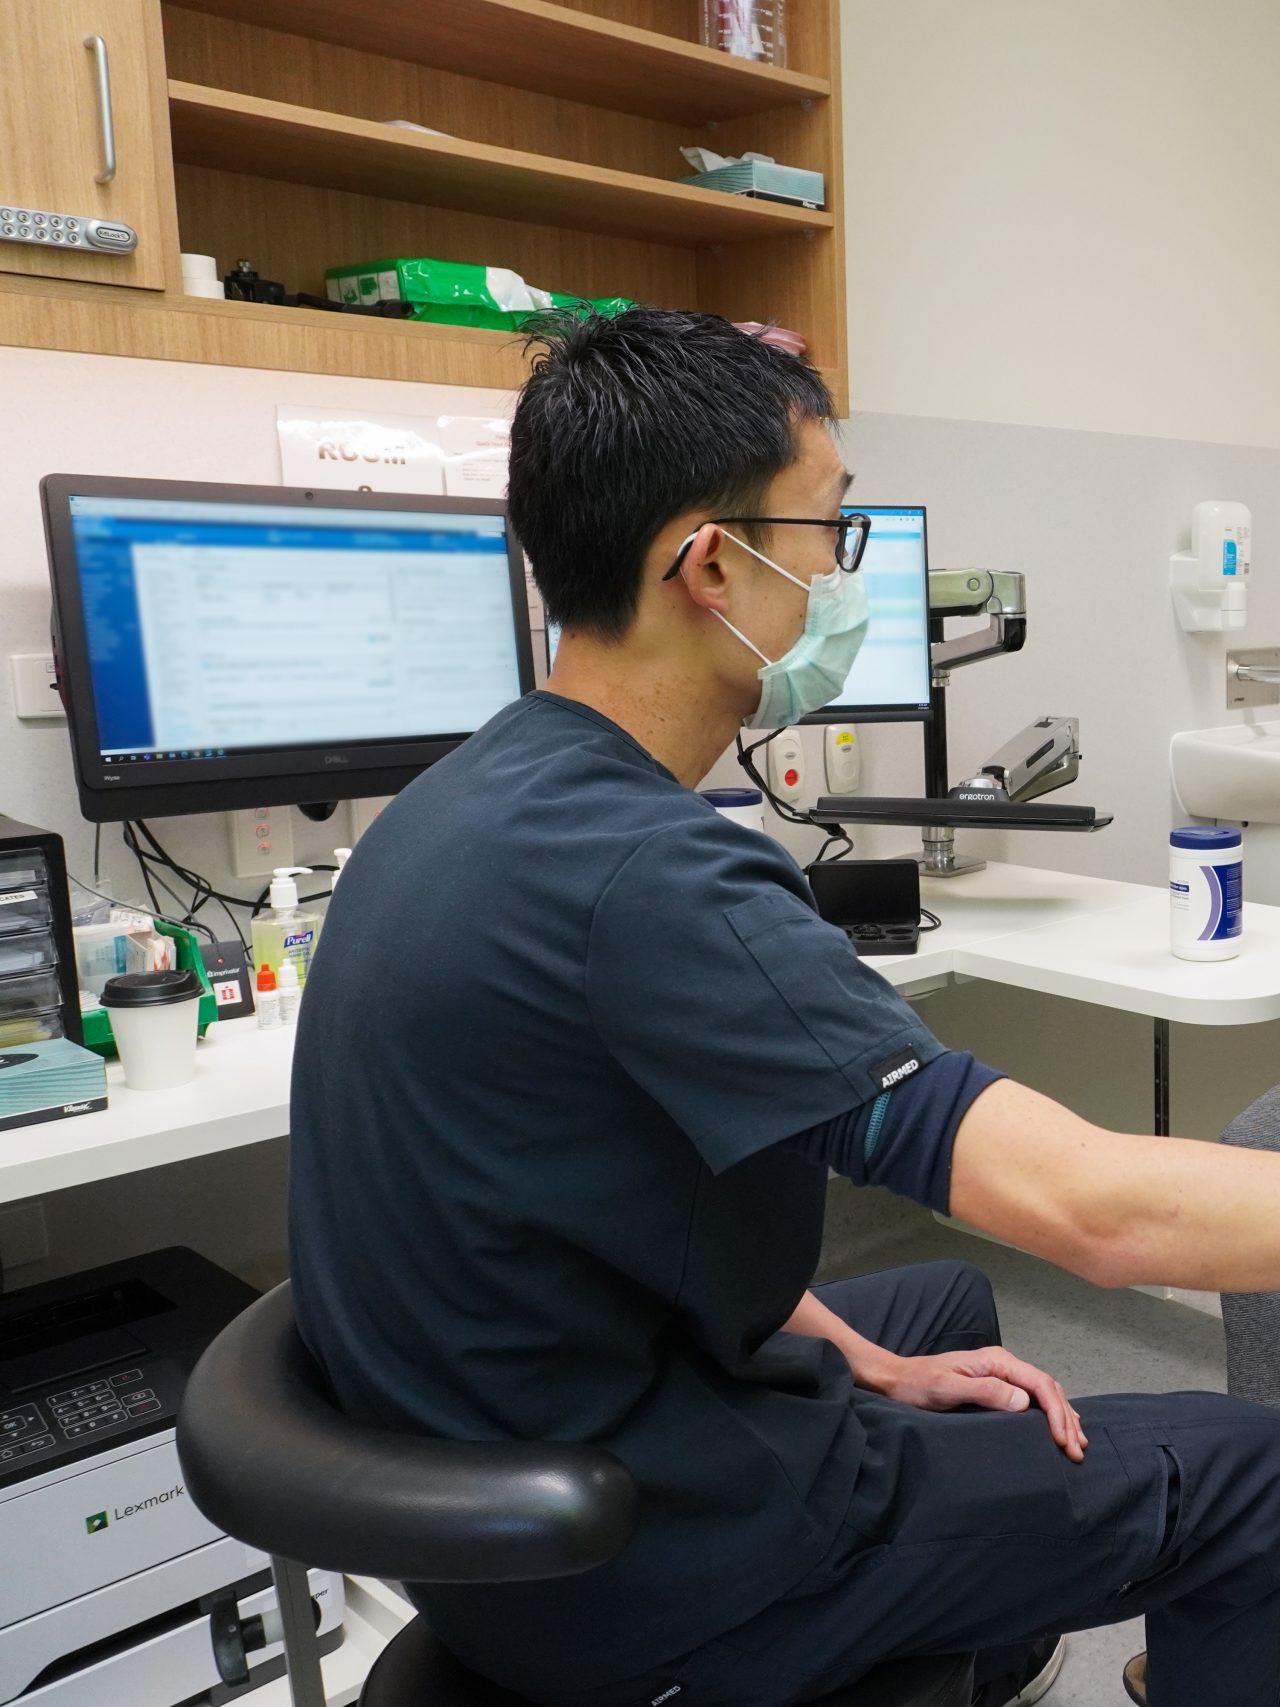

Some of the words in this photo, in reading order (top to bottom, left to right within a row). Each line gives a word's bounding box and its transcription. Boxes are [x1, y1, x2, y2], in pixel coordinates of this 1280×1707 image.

[324, 754, 349, 765] DELL
[959, 793, 995, 801] ergotron
[881, 1059, 919, 1089] AIRMED
[3, 1421, 17, 1430] OK
[114, 1485, 185, 1521] Lexmark
